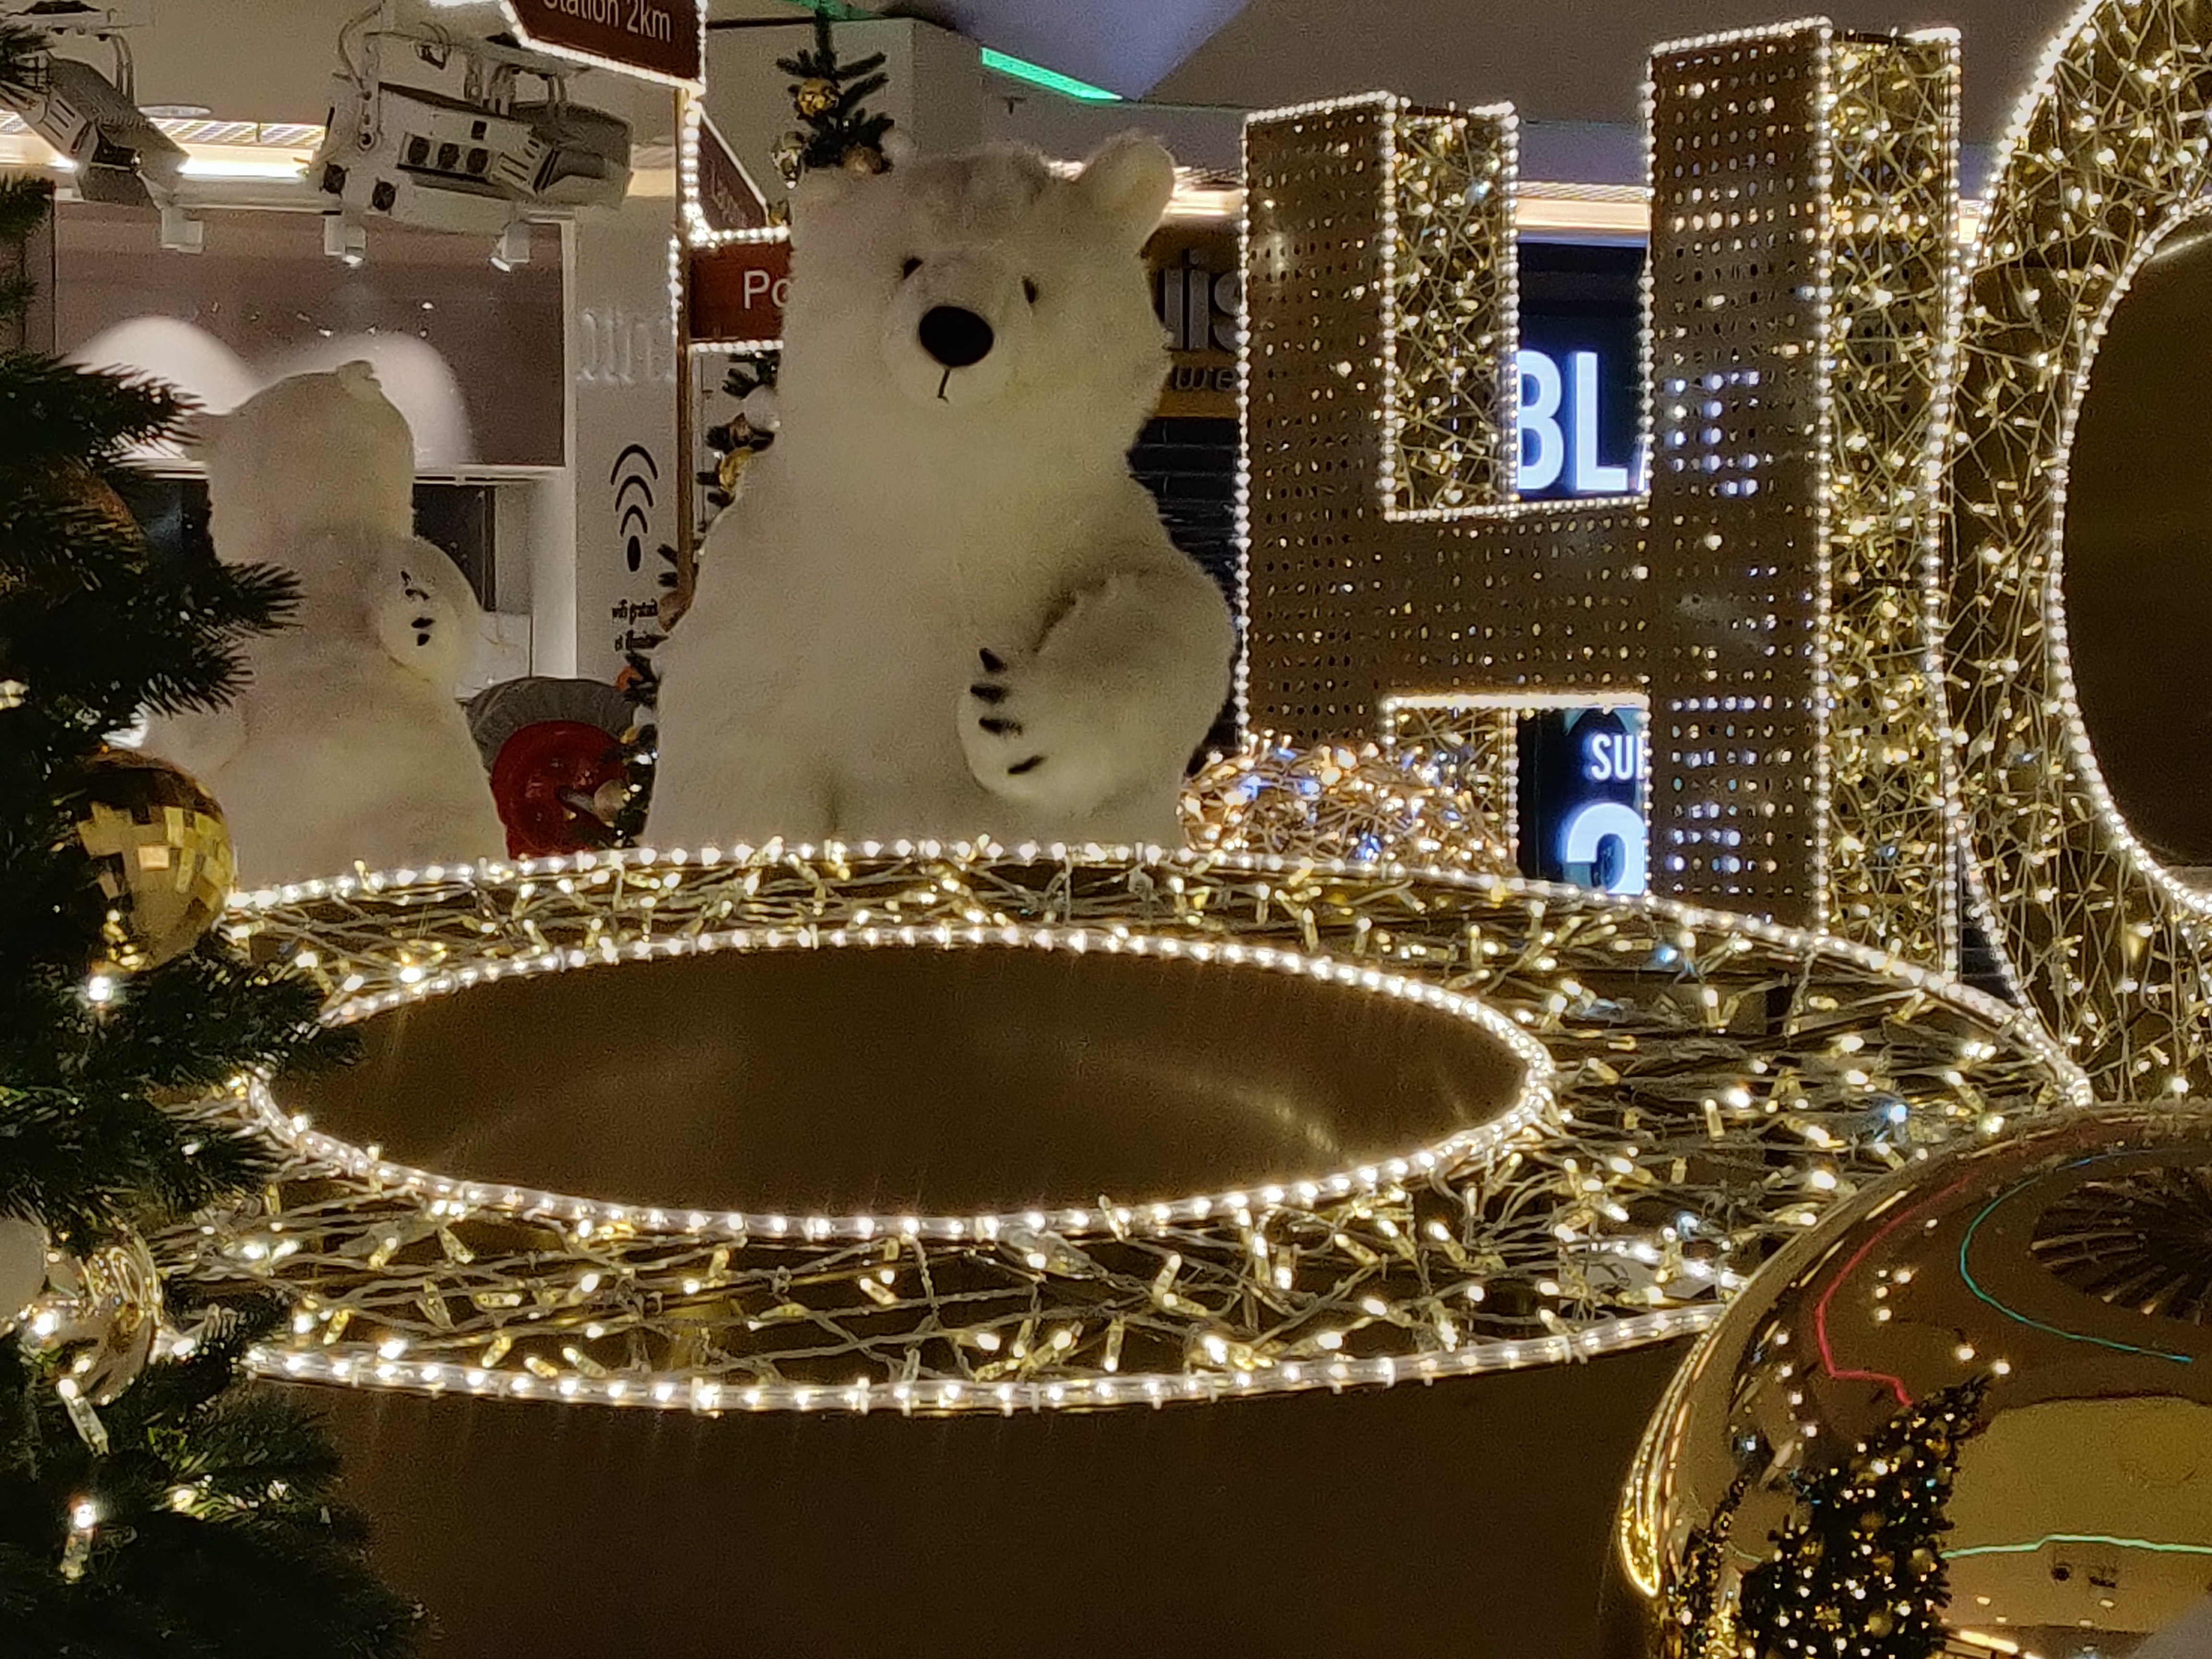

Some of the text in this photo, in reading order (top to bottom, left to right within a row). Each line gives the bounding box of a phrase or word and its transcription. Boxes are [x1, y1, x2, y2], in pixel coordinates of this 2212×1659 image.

[543, 0, 671, 43] ation 2km
[1516, 349, 1646, 491] BL
